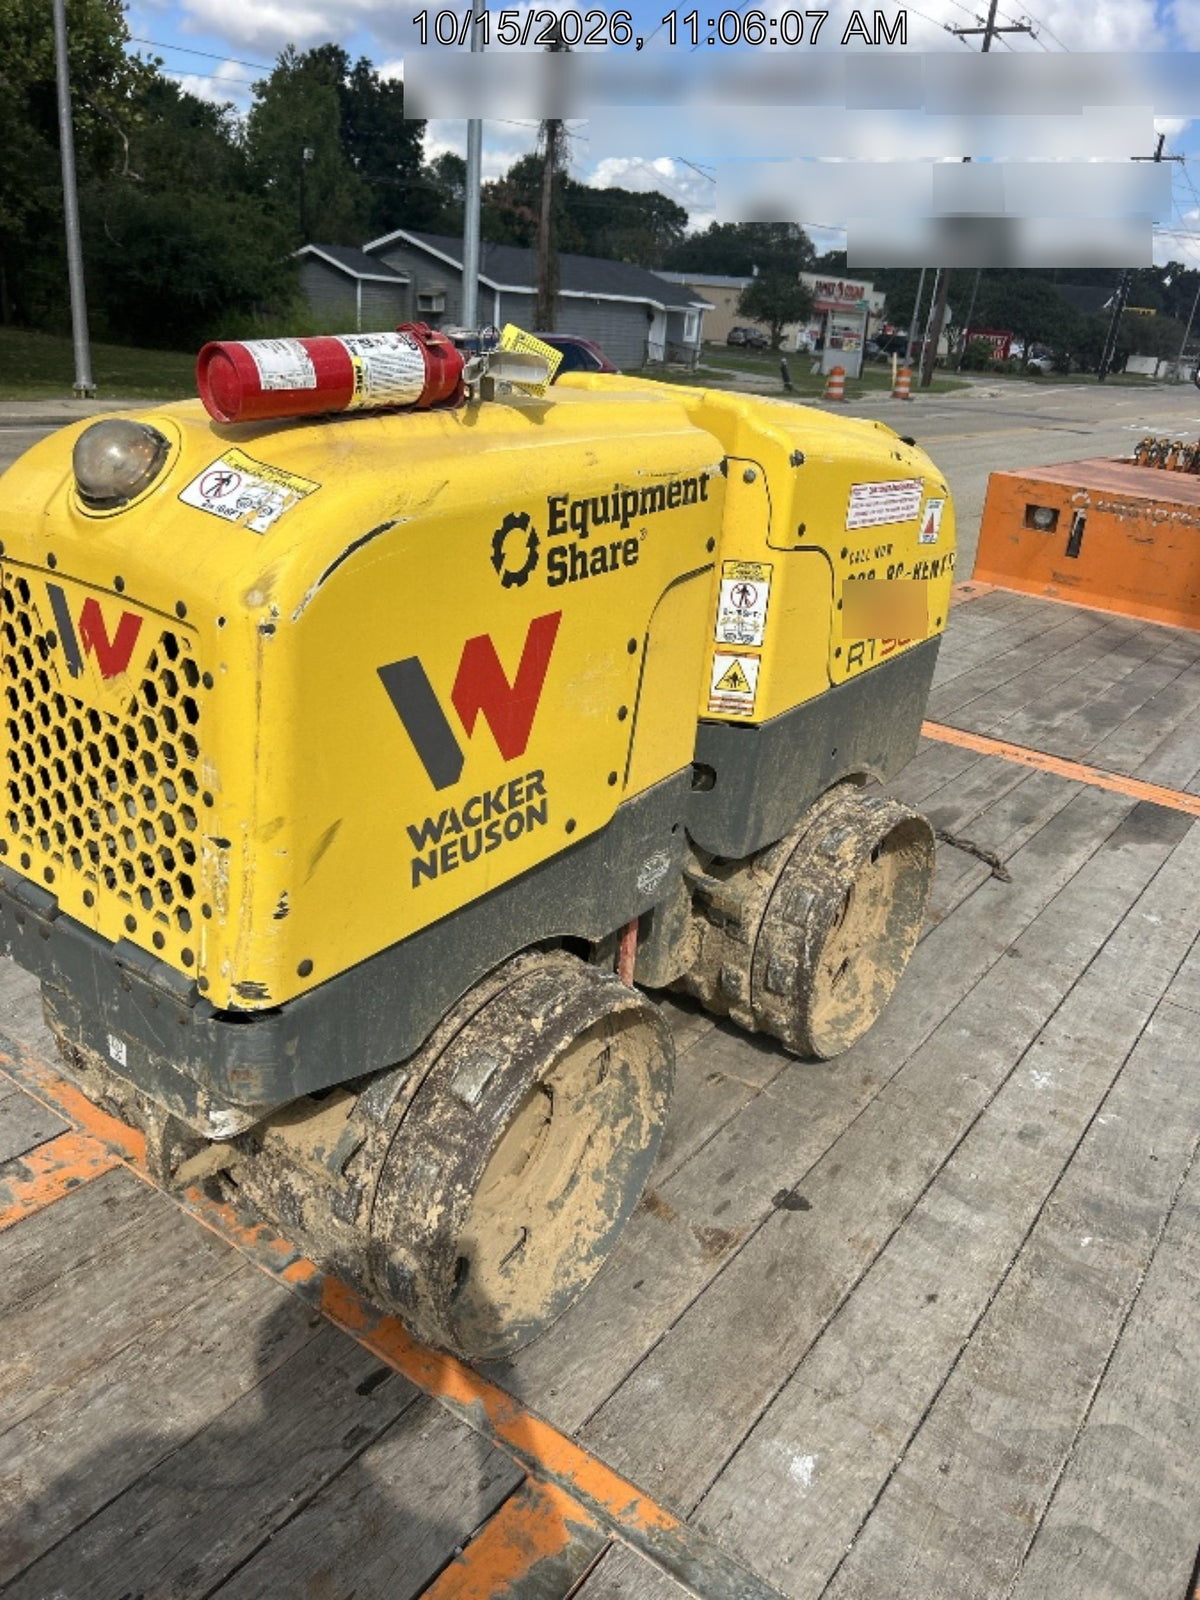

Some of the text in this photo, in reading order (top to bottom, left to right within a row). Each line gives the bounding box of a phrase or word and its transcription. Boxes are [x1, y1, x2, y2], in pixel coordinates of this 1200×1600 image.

[547, 473, 710, 538] Equipment
[406, 769, 547, 852] WACKER
[411, 798, 548, 889] NEUSON
